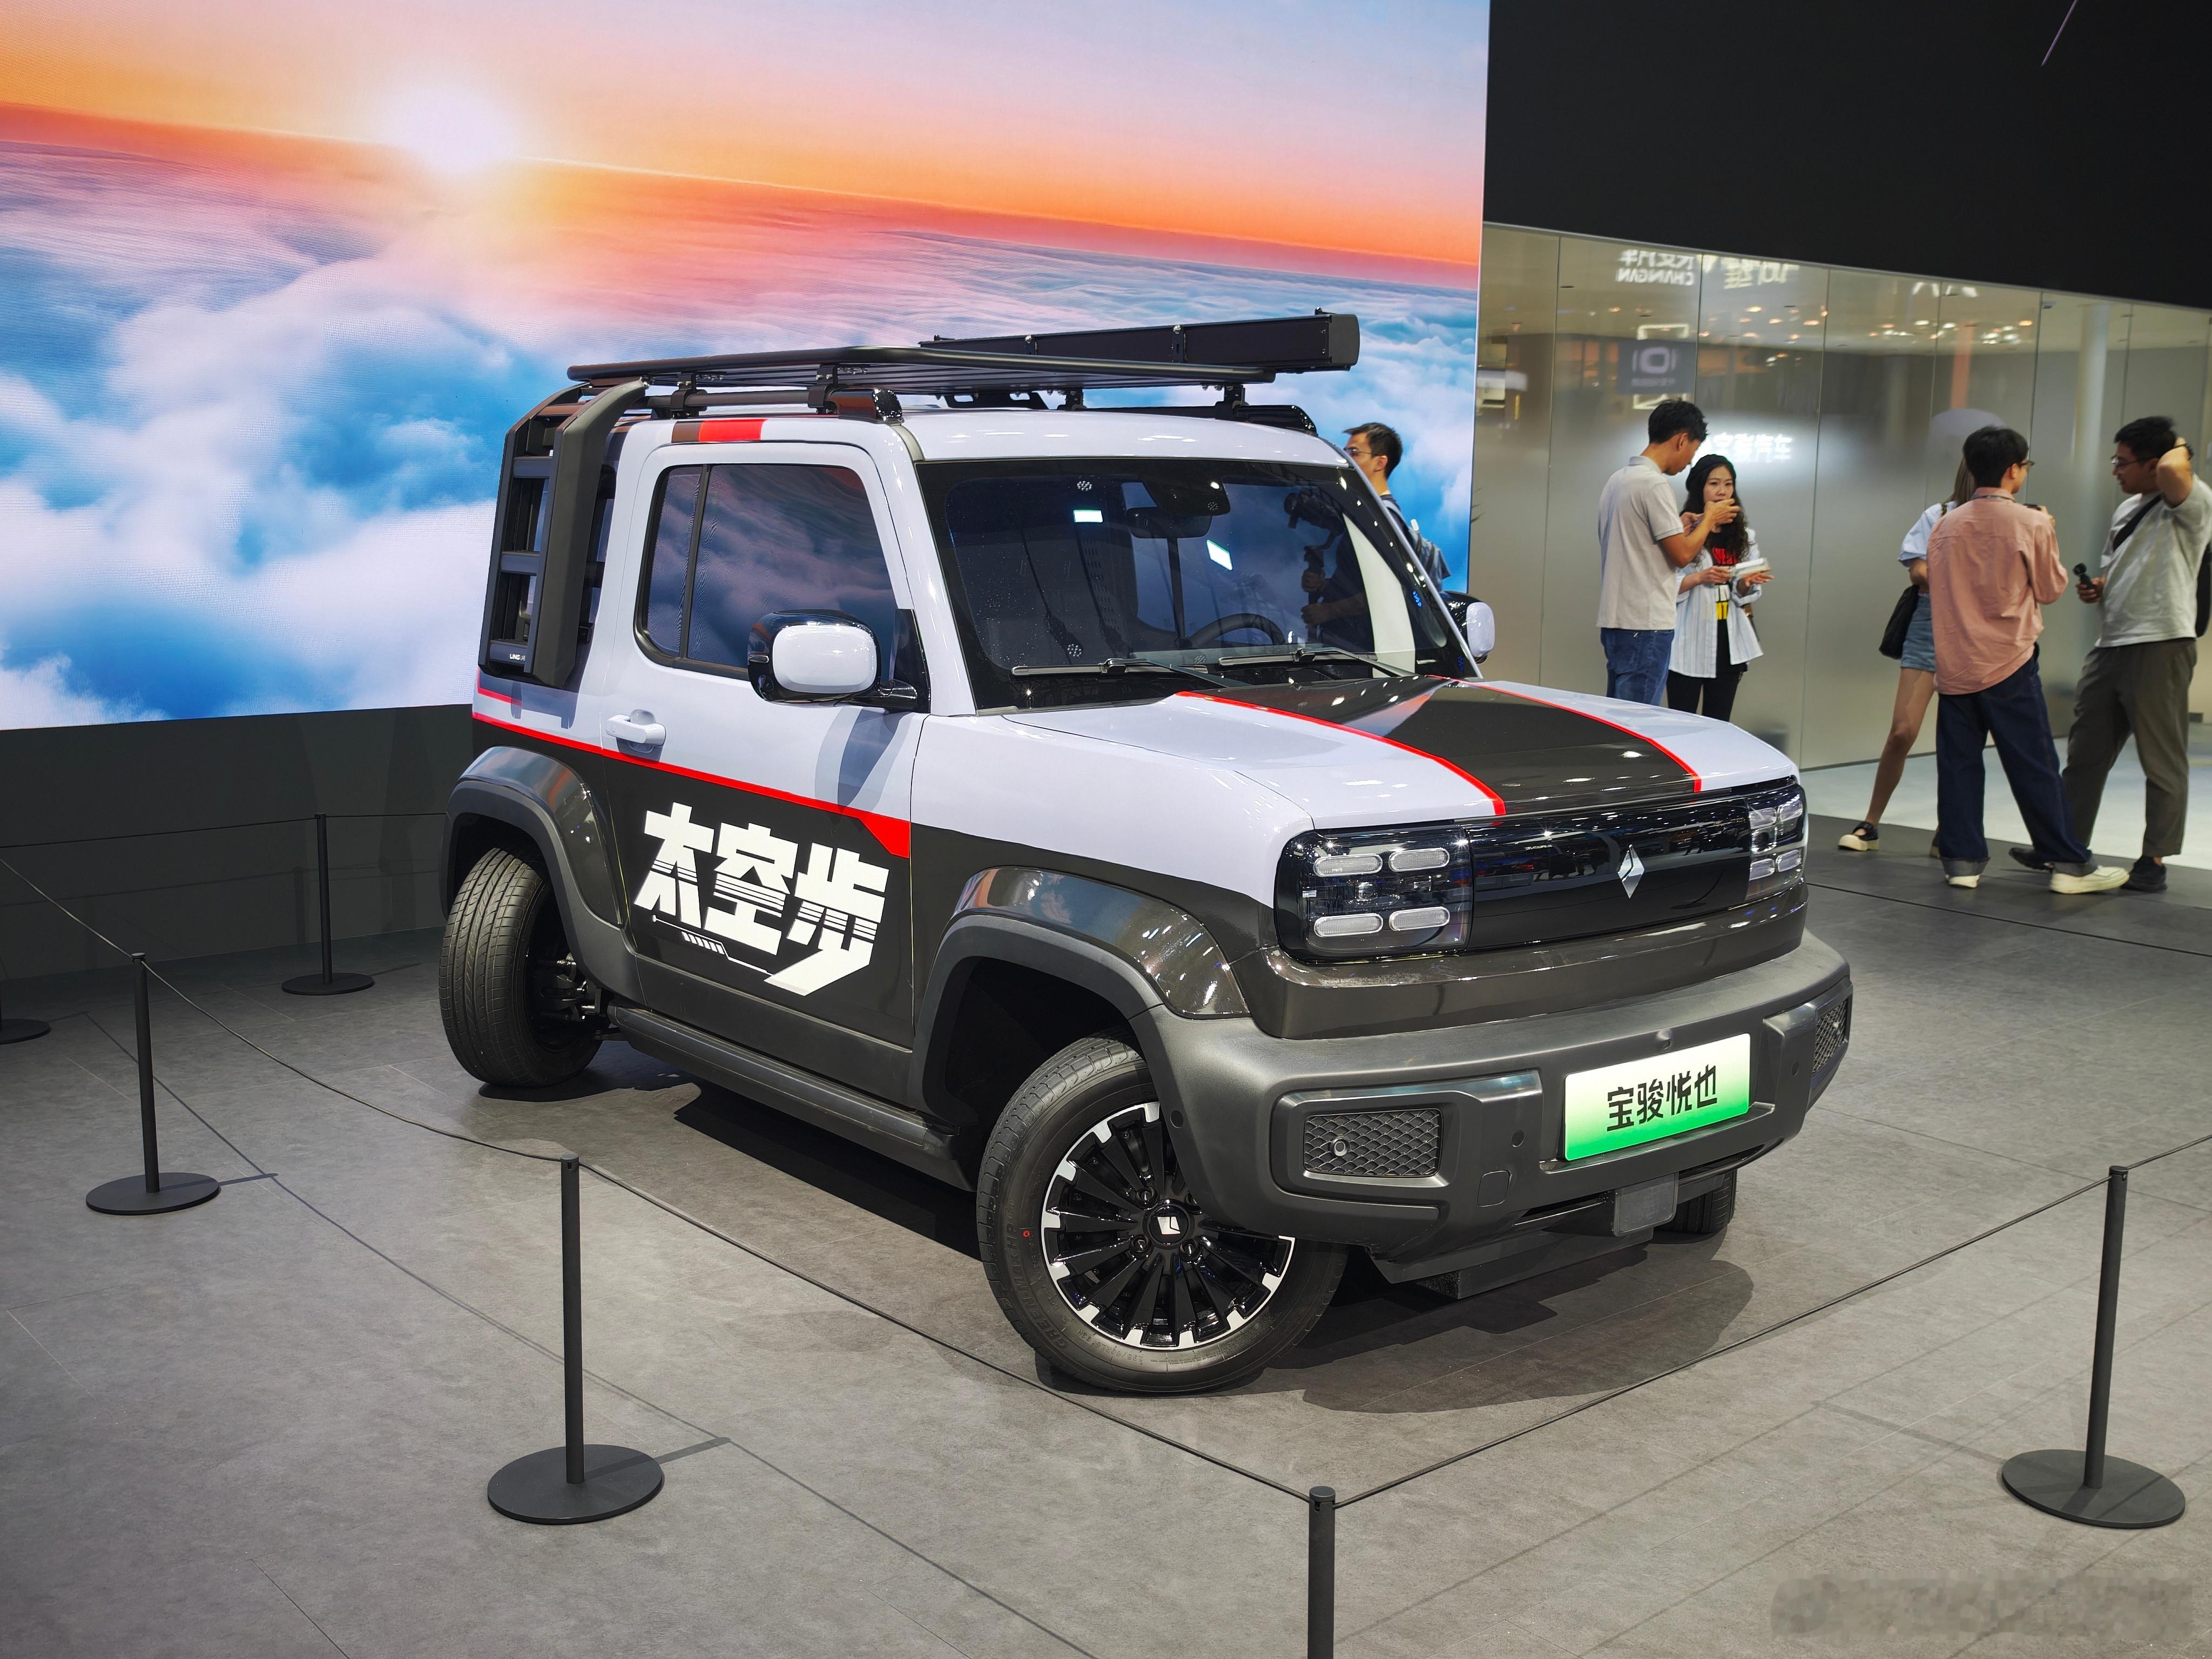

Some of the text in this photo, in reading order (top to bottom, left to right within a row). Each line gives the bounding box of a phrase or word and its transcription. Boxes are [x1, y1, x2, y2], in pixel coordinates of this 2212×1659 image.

[634, 802, 889, 996] 太空步
[1607, 1064, 1717, 1131] 宝骏悦也
